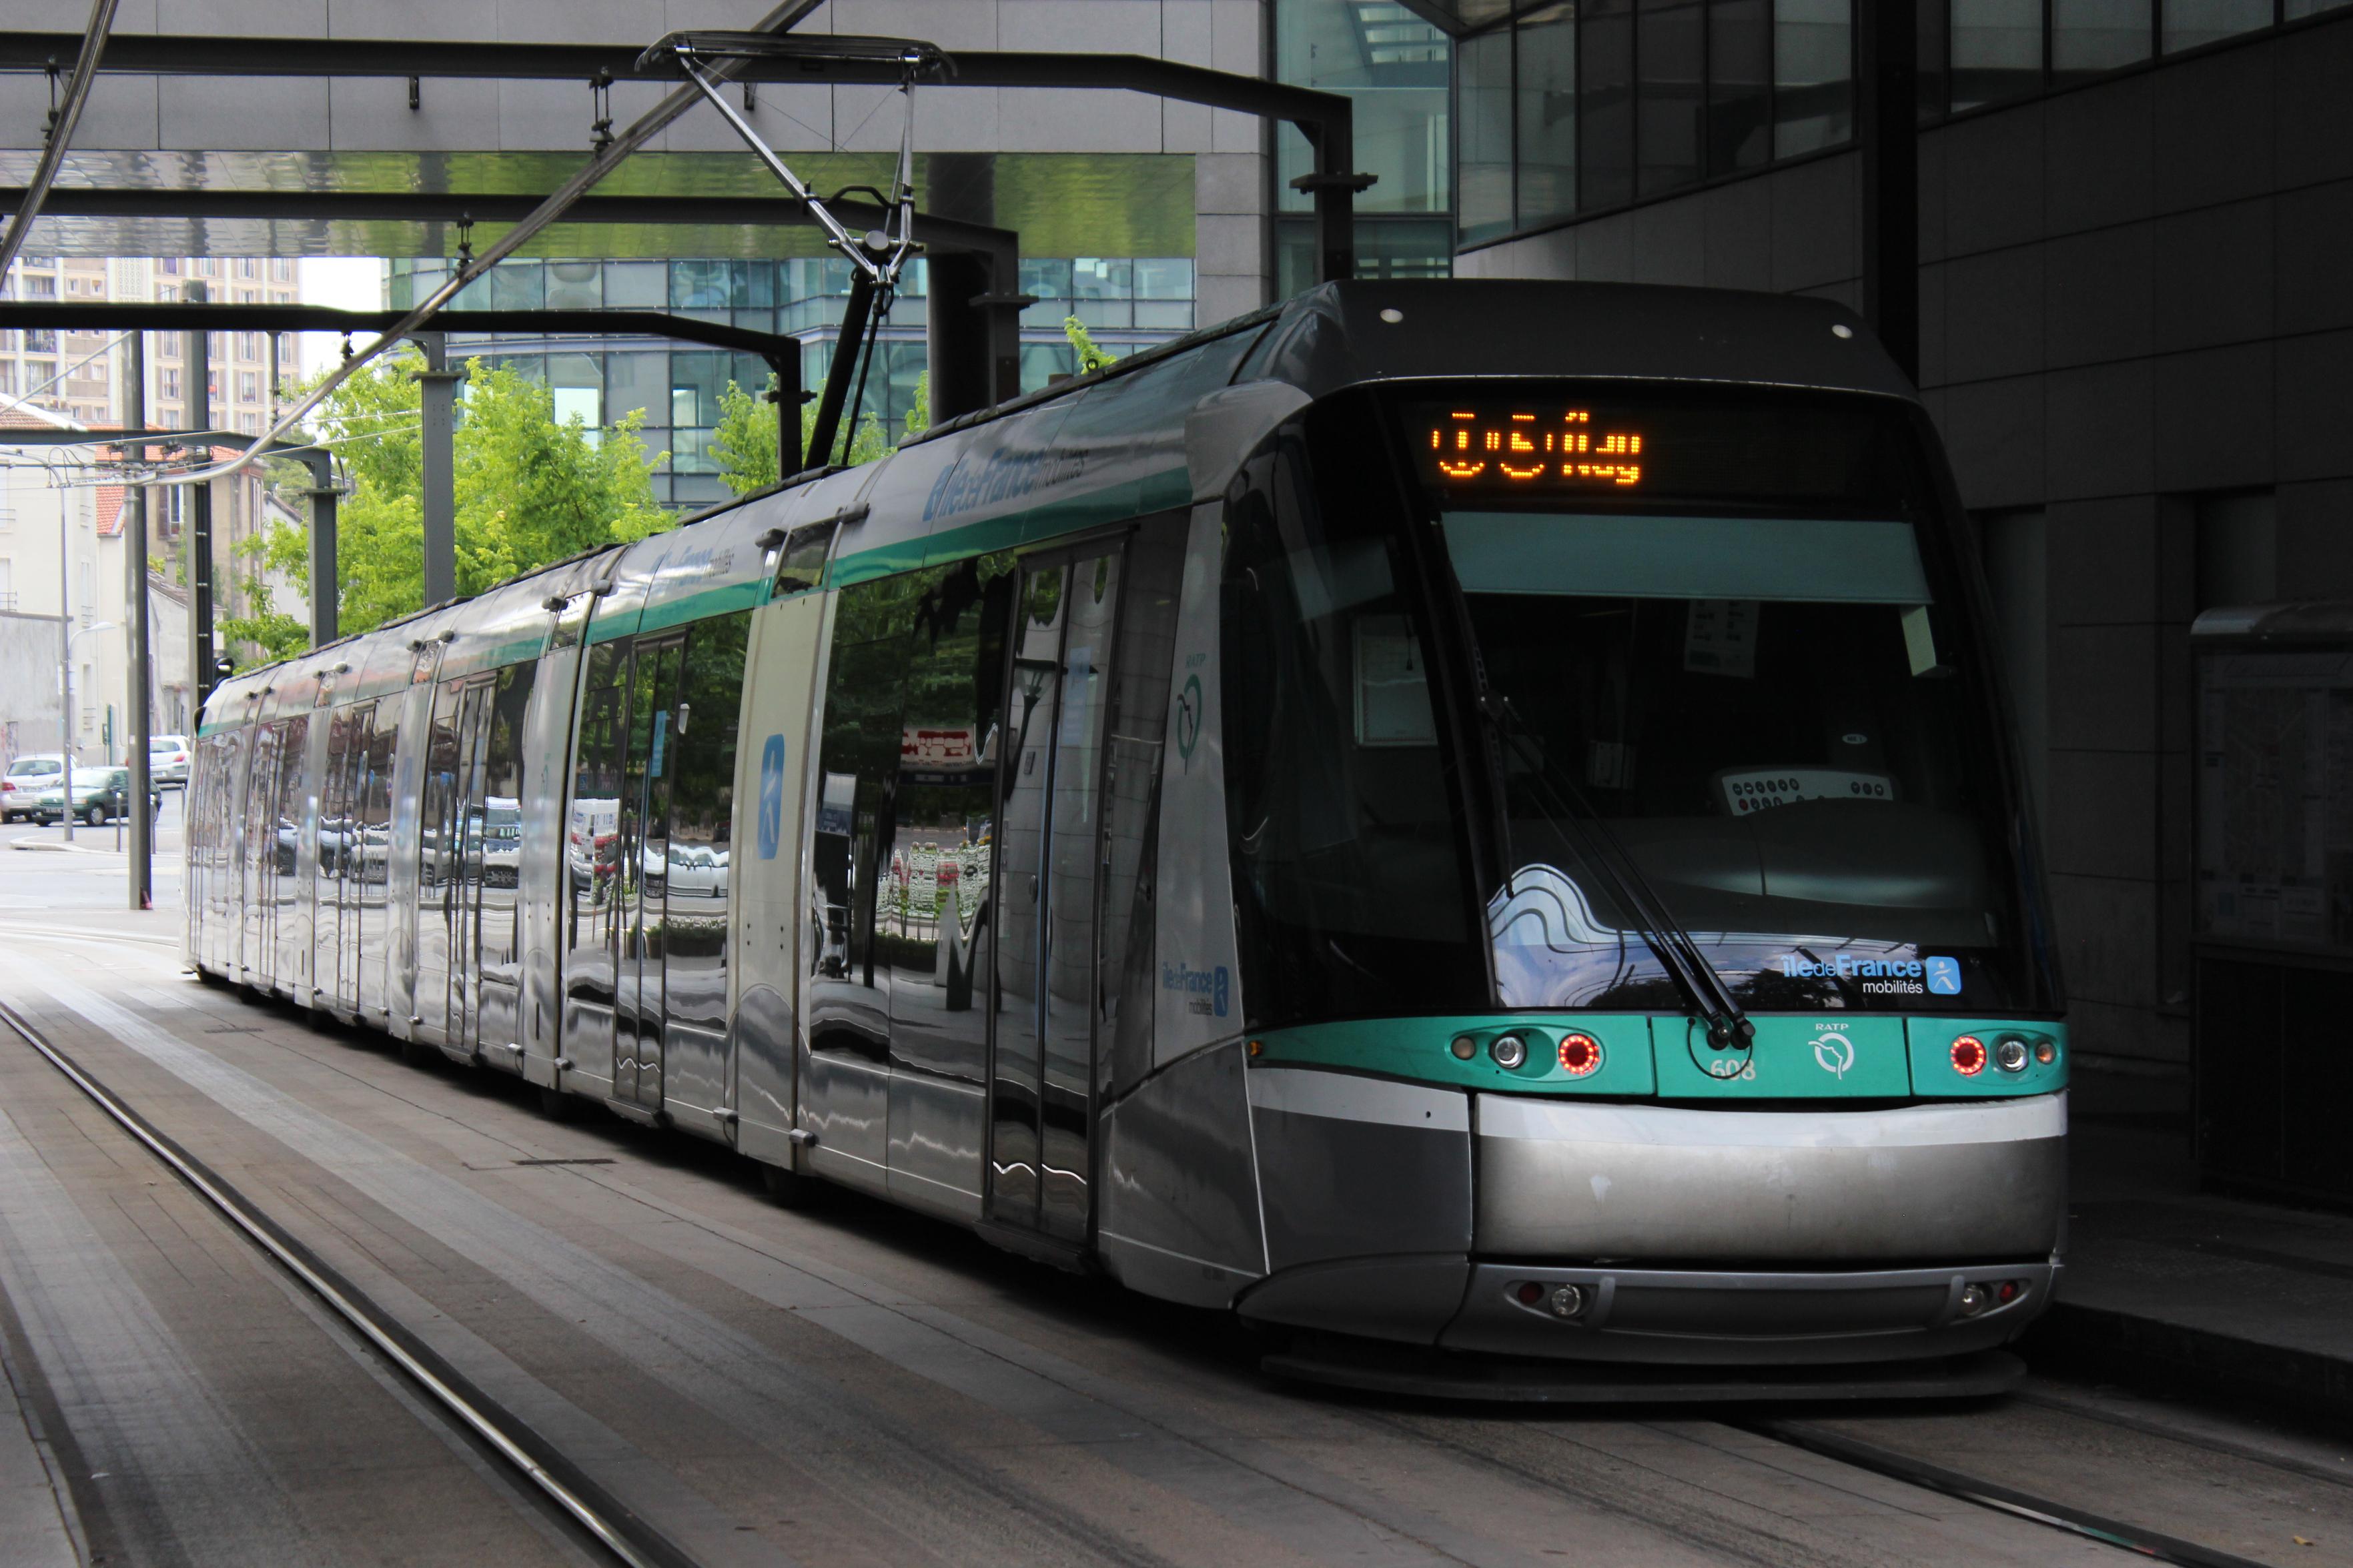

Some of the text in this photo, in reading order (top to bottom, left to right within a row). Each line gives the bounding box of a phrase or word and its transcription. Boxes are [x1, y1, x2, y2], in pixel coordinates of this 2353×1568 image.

[1863, 980, 1923, 994] mobilités
[1189, 998, 1213, 1016] mobilités
[1815, 1022, 1849, 1031] RATP
[1709, 1059, 1757, 1081] 608
